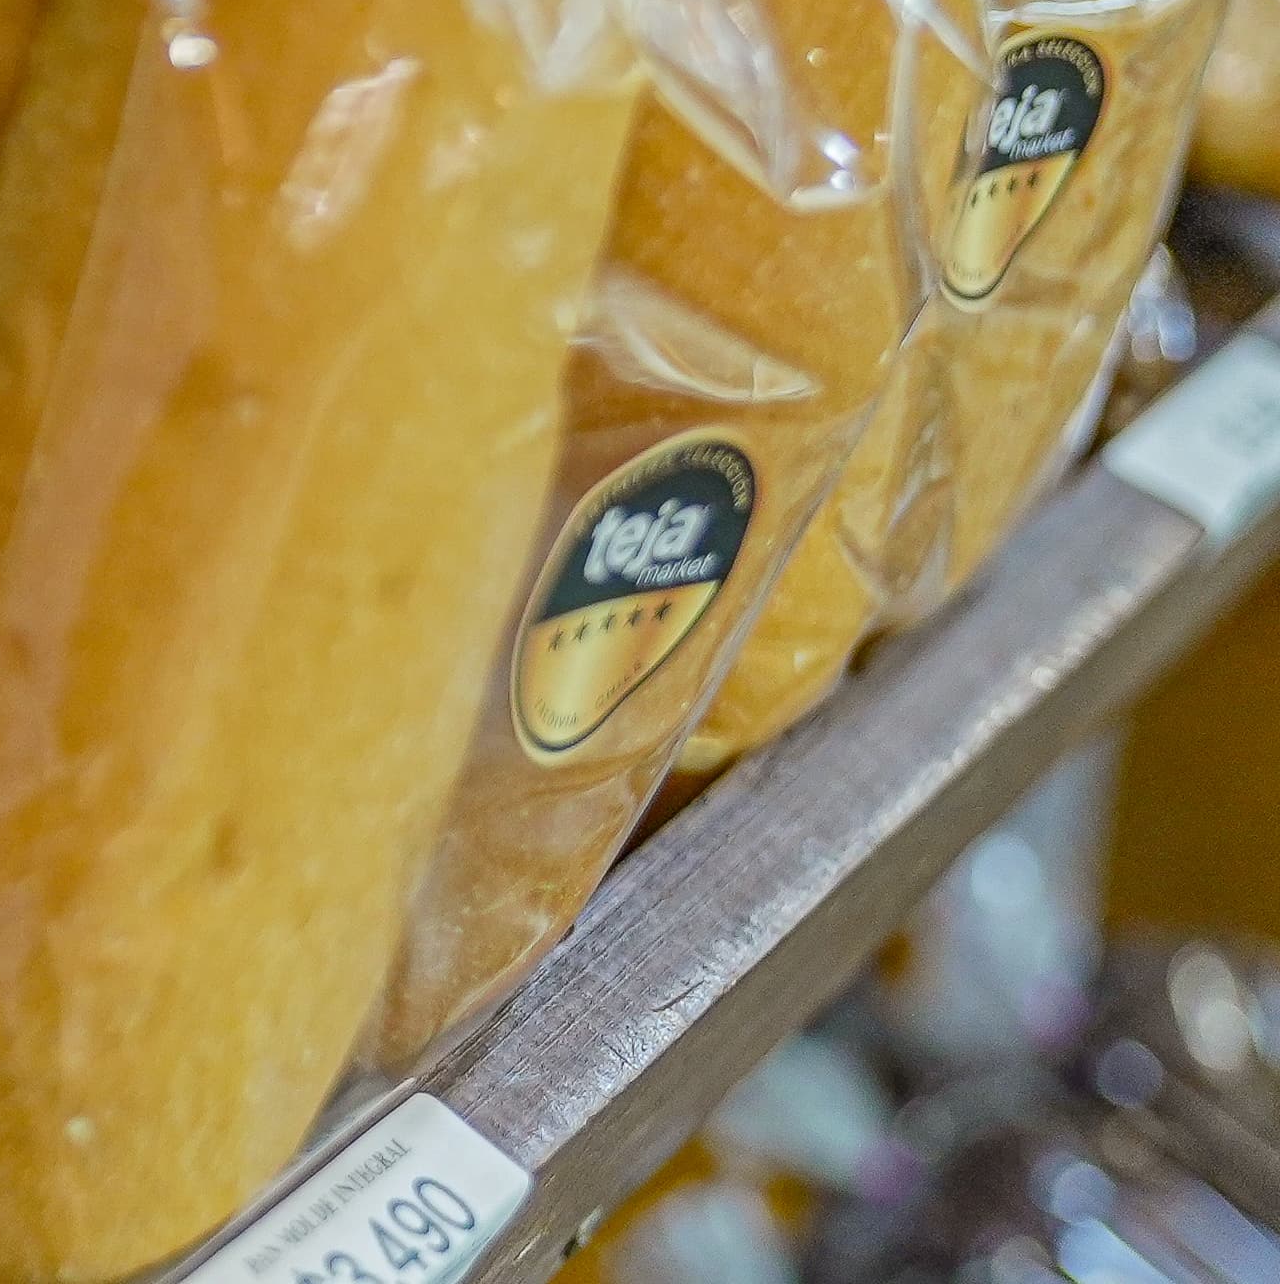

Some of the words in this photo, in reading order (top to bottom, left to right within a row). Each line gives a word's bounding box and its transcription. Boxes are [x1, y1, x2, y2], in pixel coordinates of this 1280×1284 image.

[988, 82, 1060, 155] eja
[583, 497, 706, 585] teja
[635, 551, 715, 587] market
[331, 1137, 412, 1205] INTEGRAL
